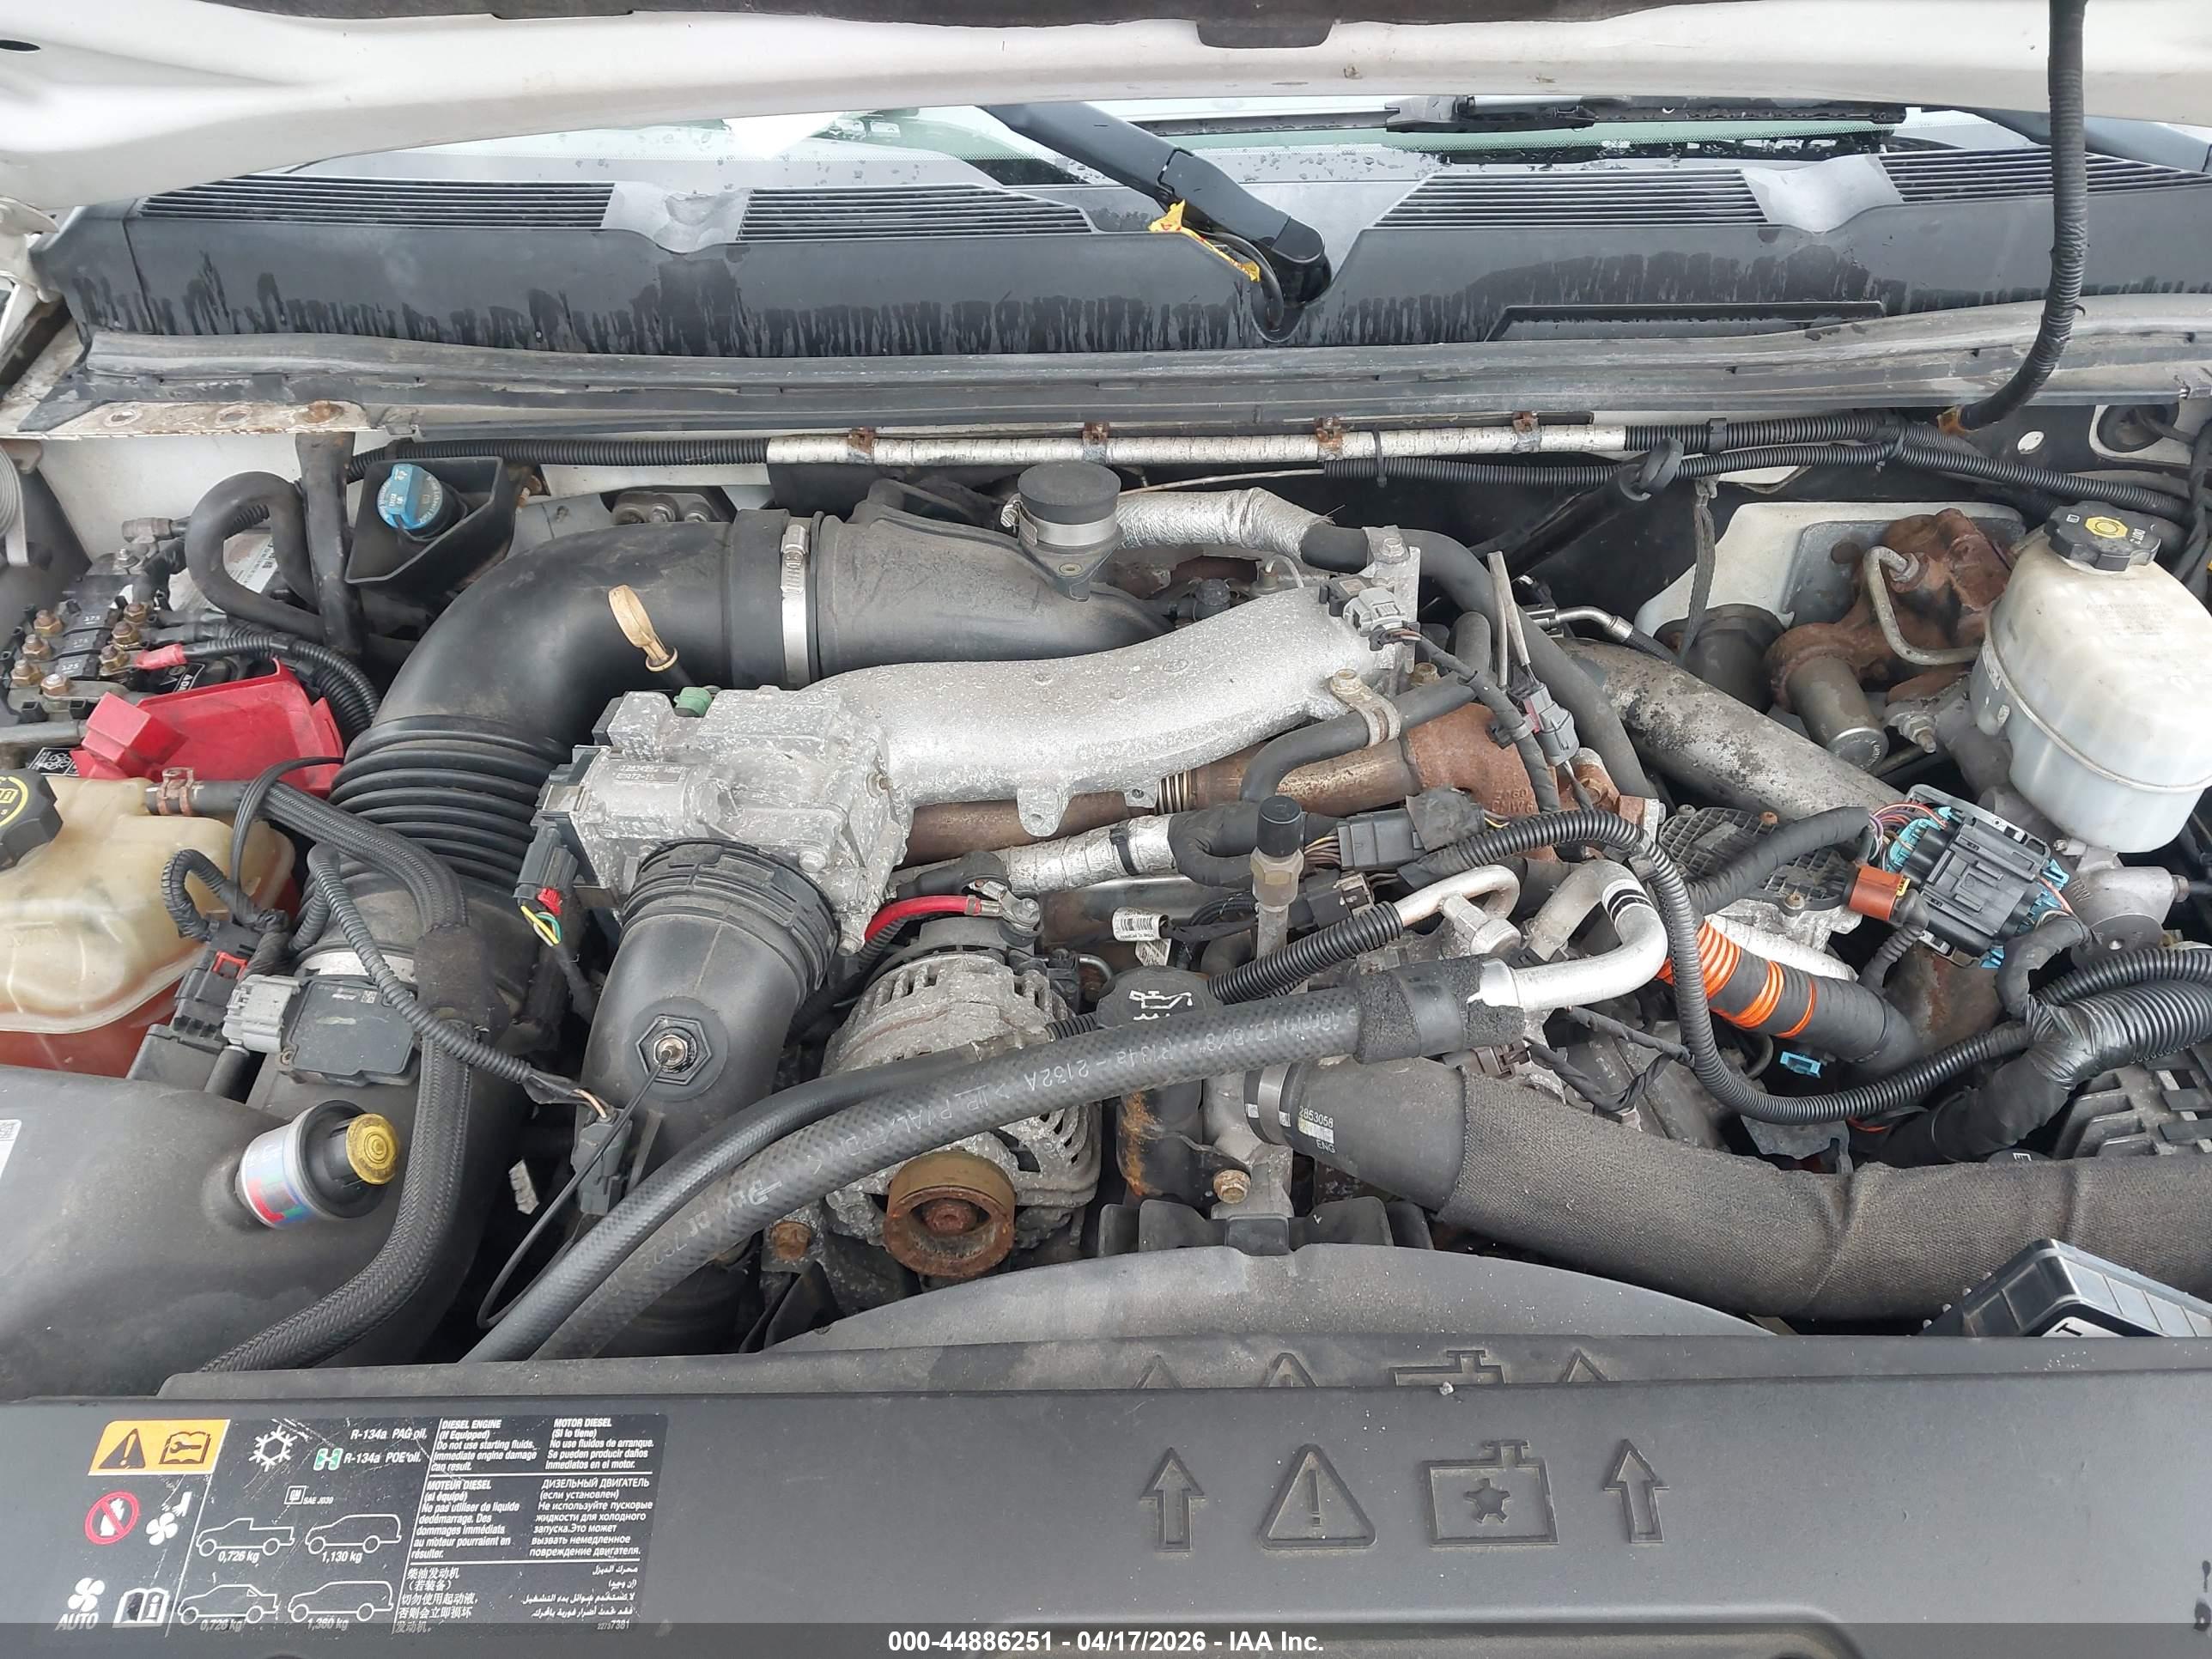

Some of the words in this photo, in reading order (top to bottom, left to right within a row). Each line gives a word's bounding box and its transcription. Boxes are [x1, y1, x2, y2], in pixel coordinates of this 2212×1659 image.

[1024, 1059, 1091, 1091] 2132A
[1298, 1105, 1334, 1128] 2853058
[1316, 1139, 1336, 1154] ENG
[441, 1419, 470, 1429] DIESEL
[471, 1419, 501, 1429] ENGINE
[554, 1419, 583, 1428] MOTOR
[585, 1418, 612, 1427] DIESEL
[350, 1429, 386, 1440] R-134a
[452, 1430, 490, 1441] Equipped)
[436, 1441, 448, 1450] Do
[449, 1441, 461, 1449] not
[479, 1440, 510, 1451] starting
[550, 1439, 561, 1448] No
[606, 1438, 617, 1447] de
[343, 1452, 380, 1463] R-134a
[433, 1451, 475, 1461] Immediate
[477, 1451, 505, 1462] engine
[505, 1450, 538, 1462] damage
[547, 1449, 558, 1459] Se
[559, 1449, 589, 1461] pueden
[590, 1461, 600, 1469] en
[427, 1480, 462, 1491] MOTEUR
[463, 1480, 492, 1490] DIESEL
[541, 1478, 598, 1490] ДИЗЕЛЬНЫЙ
[599, 1477, 650, 1489] ДВИГАТЕЛЬ
[540, 1491, 564, 1501] (если
[565, 1489, 619, 1501] установлен)
[538, 1501, 550, 1510] Не
[552, 1501, 608, 1512] используйте
[610, 1501, 653, 1511] пусковые
[476, 1513, 492, 1523] Des
[535, 1513, 579, 1523] жидкости
[580, 1513, 598, 1522] для
[599, 1512, 646, 1522] холодного
[416, 1526, 461, 1537] dommages
[587, 1523, 617, 1533] может
[426, 1537, 456, 1547] moteur
[500, 1537, 511, 1546] en
[532, 1535, 568, 1545] вызвать
[569, 1534, 631, 1545] немедленное
[246, 1551, 260, 1564] kg
[322, 1551, 349, 1563] 1,130
[349, 1551, 362, 1564] kg
[529, 1547, 592, 1558] повреждение
[592, 1547, 641, 1558] двигателя.
[407, 1566, 459, 1580] 柴油发动机
[55, 1613, 99, 1631] AUTO
[229, 1619, 242, 1632] kg
[335, 1619, 349, 1631] kg
